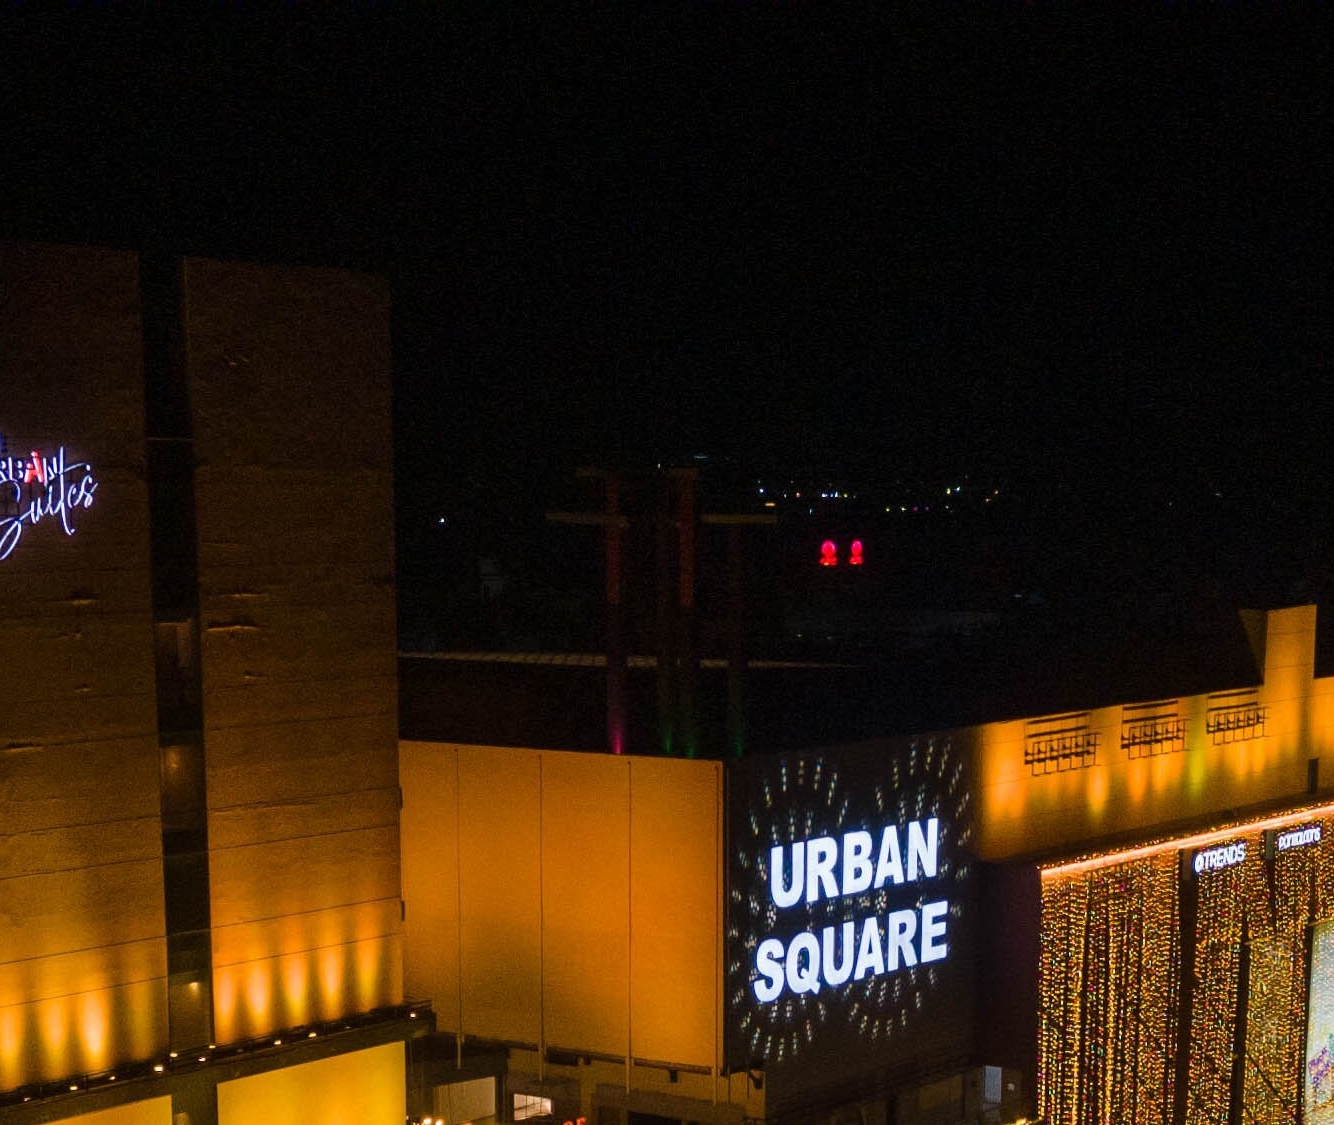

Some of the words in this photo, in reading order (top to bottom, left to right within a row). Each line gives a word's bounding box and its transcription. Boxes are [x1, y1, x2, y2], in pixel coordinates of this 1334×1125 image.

[770, 817, 940, 908] URBAN
[1203, 843, 1245, 870] TRENDS
[753, 901, 949, 1002] SQUARE
